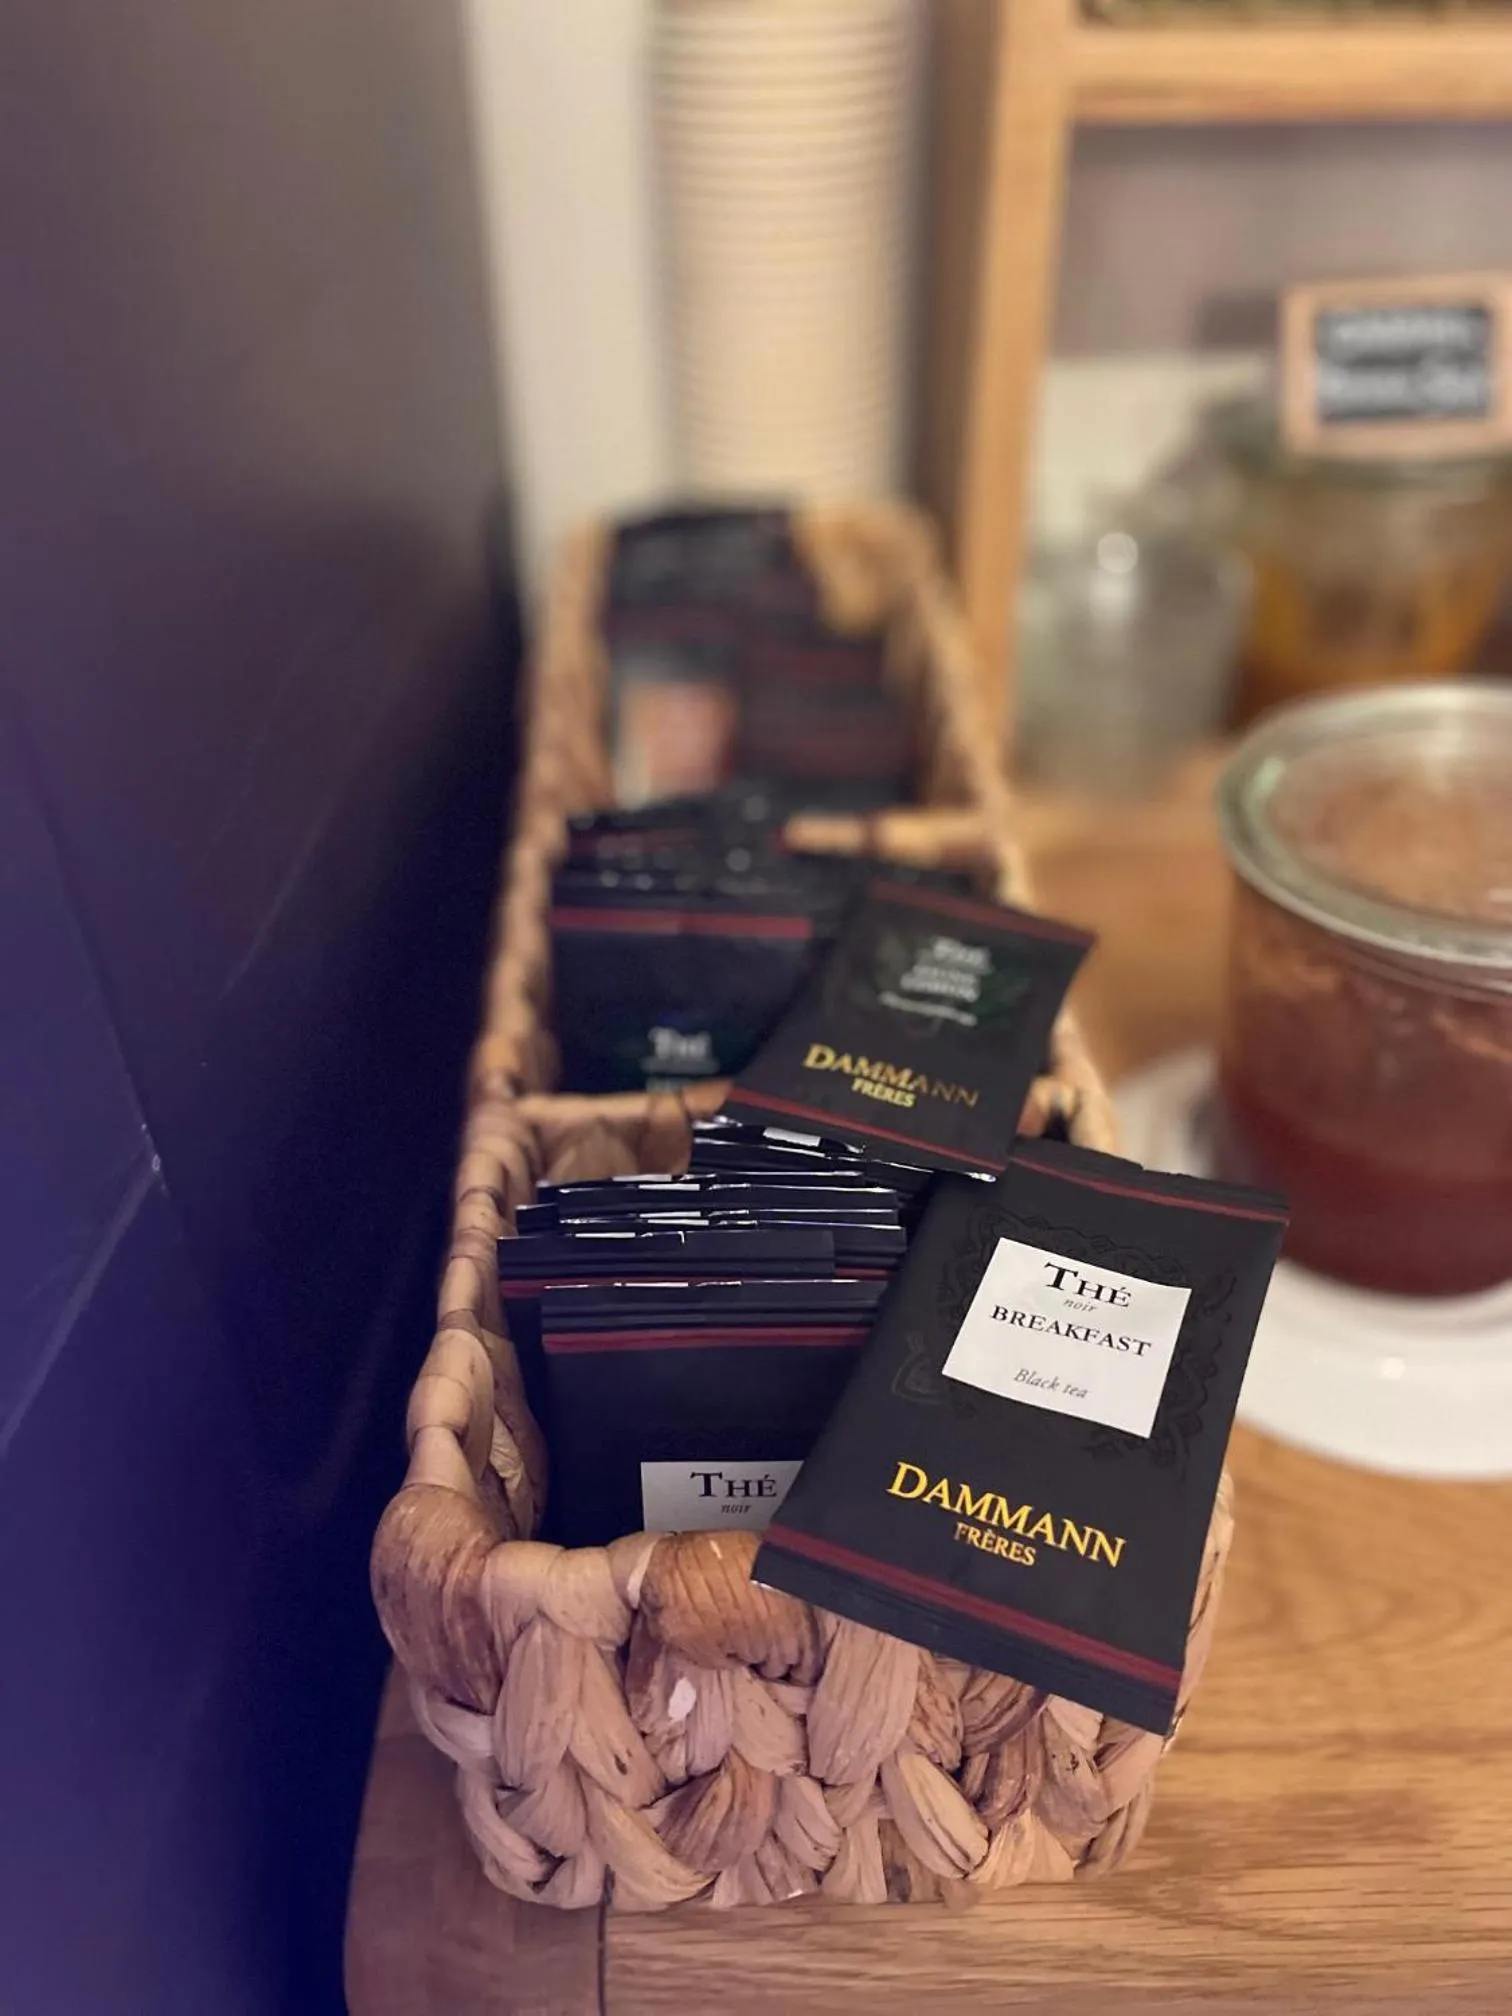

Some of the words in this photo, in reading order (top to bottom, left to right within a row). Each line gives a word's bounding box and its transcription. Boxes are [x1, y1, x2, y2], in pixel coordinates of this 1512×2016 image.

[803, 1043, 979, 1108] DAMMANN
[1044, 1262, 1131, 1307] THÉ
[1063, 1299, 1098, 1312] noir
[990, 1305, 1152, 1356] BREAKFAST
[1012, 1367, 1059, 1392] Black
[1063, 1380, 1088, 1399] tea
[690, 1472, 777, 1498] THÉ
[720, 1503, 752, 1515] noir
[887, 1462, 1127, 1567] DAMMANN
[953, 1522, 1036, 1567] FRÈRES
